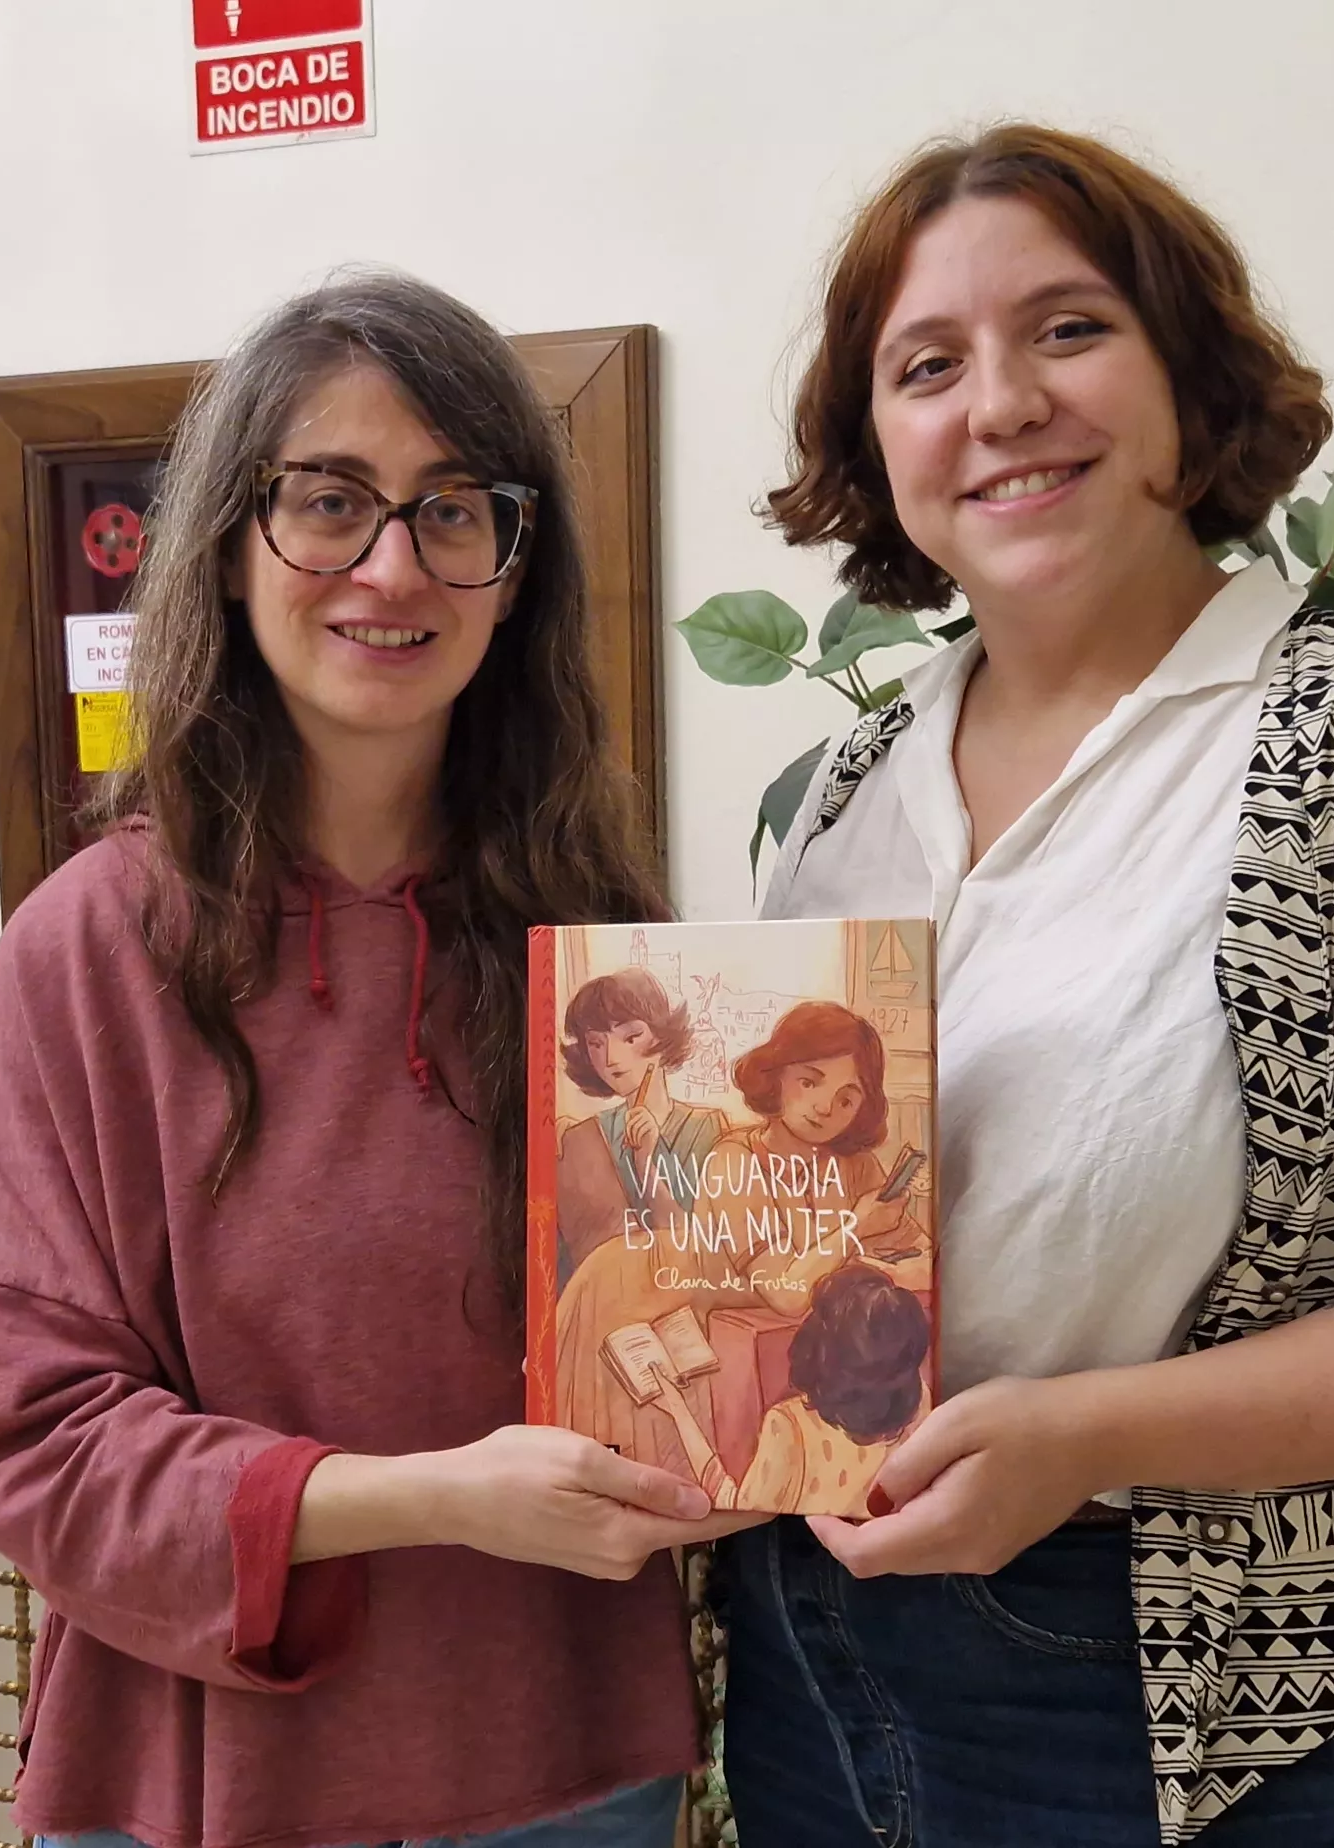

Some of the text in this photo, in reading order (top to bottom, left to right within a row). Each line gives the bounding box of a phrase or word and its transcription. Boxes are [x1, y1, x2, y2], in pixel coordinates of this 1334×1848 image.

[210, 50, 350, 95] BOCA DE
[207, 91, 355, 136] INCENDIO
[98, 624, 135, 639] ROM
[87, 646, 107, 661] EN
[868, 1007, 909, 1033] 1927
[624, 1205, 865, 1259] ES UNA MUJER
[654, 1266, 808, 1293] Clara de Frutos
